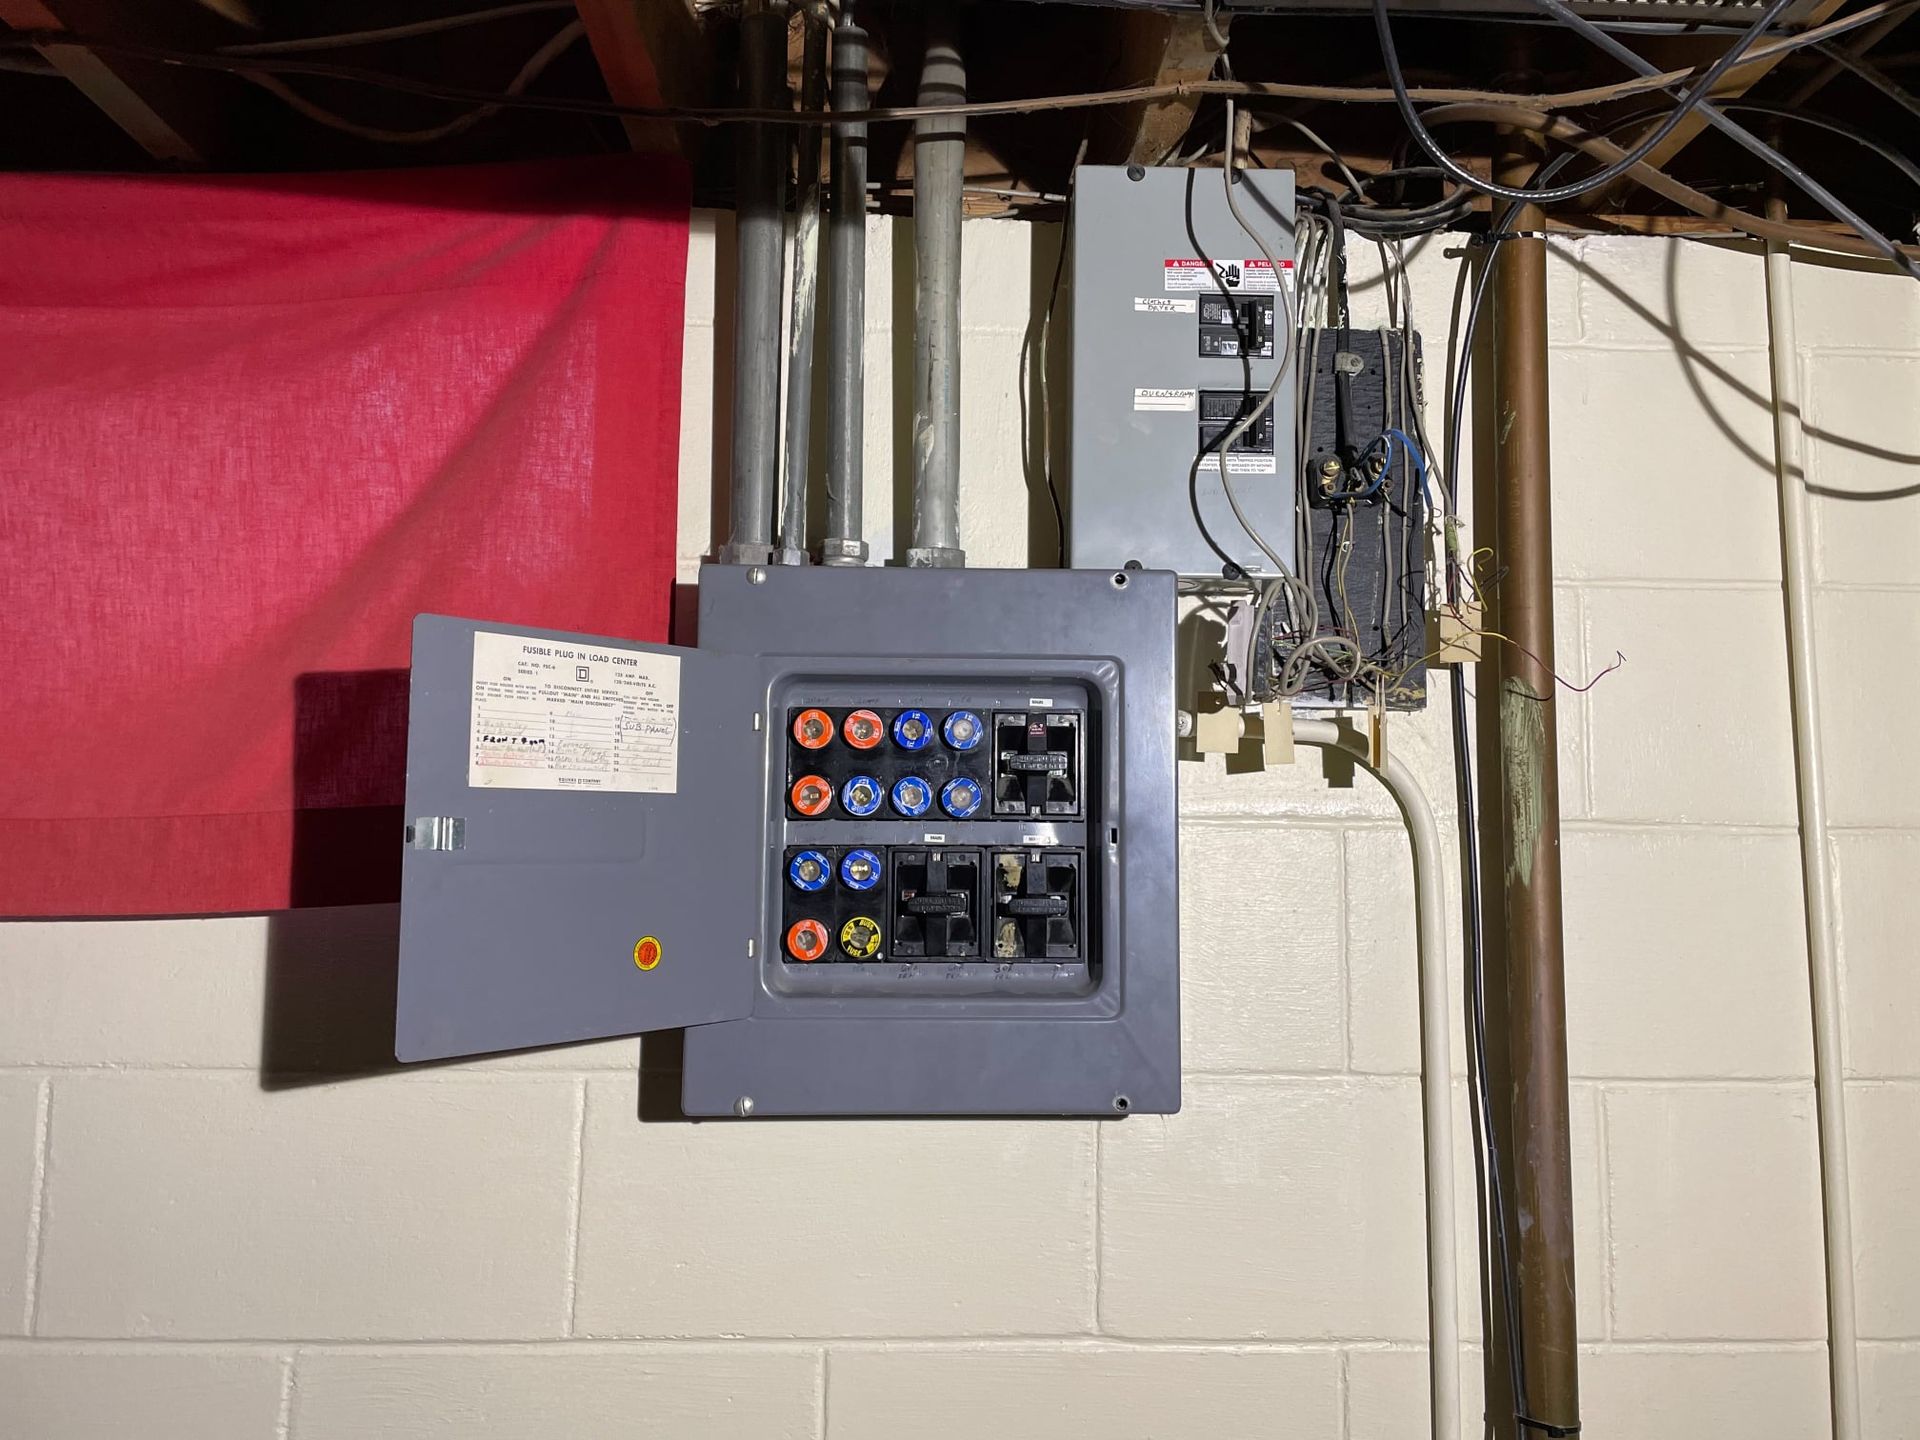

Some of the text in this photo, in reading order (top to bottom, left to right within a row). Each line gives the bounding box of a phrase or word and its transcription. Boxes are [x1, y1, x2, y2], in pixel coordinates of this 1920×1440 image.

[522, 646, 552, 656] FUSIBLE
[554, 650, 574, 659] PLUG
[589, 654, 609, 663] LOAD
[612, 657, 638, 666] CENTER
[623, 721, 641, 731] SUB
[859, 920, 874, 930] BUSS
[847, 945, 863, 956] FUSE
